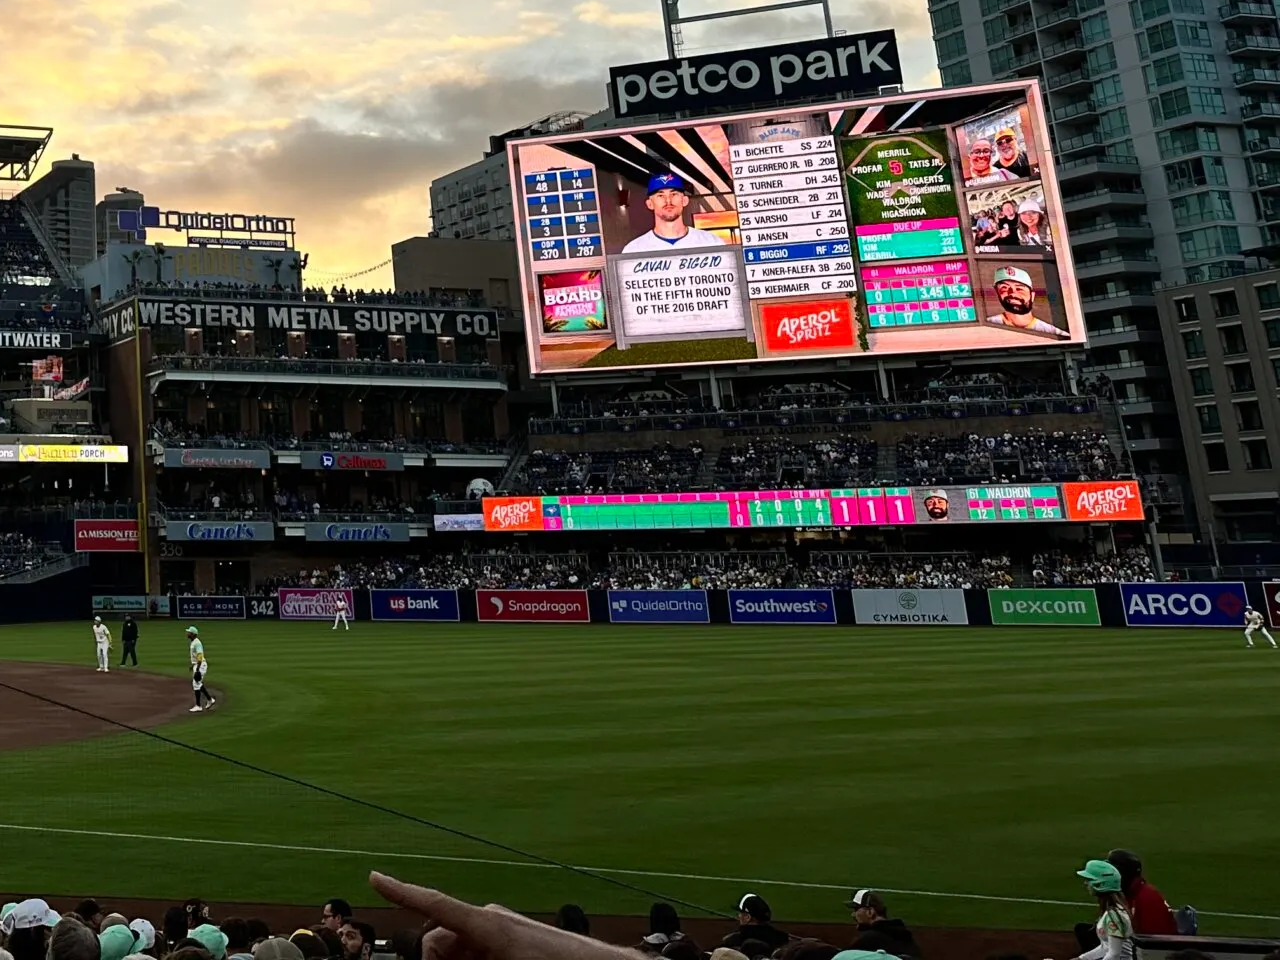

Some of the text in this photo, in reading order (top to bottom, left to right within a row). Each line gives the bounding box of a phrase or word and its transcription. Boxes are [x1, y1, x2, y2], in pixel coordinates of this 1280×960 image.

[616, 40, 893, 113] petco park
[759, 127, 801, 140] BLUE JAYS
[745, 140, 833, 157] BICHETTE SS .224
[877, 148, 911, 158] MERRILL
[734, 157, 836, 175] 27 GUERRERO 1B .208
[852, 164, 883, 175] PROFAR
[908, 159, 930, 169] TATIS
[536, 182, 548, 191] 48
[572, 179, 582, 188] 14
[739, 174, 838, 192] 2 TURNER DH .345
[876, 180, 891, 188] KIM
[902, 175, 944, 186] BOGAERTS
[866, 190, 890, 199] WADE
[909, 184, 951, 196] CRONENWORTH
[738, 192, 839, 209] 36 SCHNEIDER 2B .211
[882, 196, 921, 206] WALDRON
[541, 205, 547, 214] 4
[881, 208, 927, 219] HIGASHIOKA
[166, 211, 287, 232] QuidelOrtho
[741, 209, 842, 226] 25 VARSHO LF .214
[544, 227, 550, 236] 3
[580, 224, 586, 233] 5
[893, 221, 922, 231] DUE UP
[745, 226, 846, 243] 9 JANSEN C .250
[862, 234, 892, 243] PROFAR
[540, 249, 559, 260] .370
[576, 246, 594, 256] .787
[748, 244, 849, 260] 8 BIGGIO RF .292
[863, 244, 878, 252] KIM
[864, 252, 897, 261] MERRILL
[174, 250, 254, 282] PADRES
[634, 256, 721, 274] CAVAN BIGGIO
[750, 262, 851, 277] 7 KINER-FALEFA 3B .260
[894, 263, 962, 275] WALDRON RHP
[625, 273, 734, 290] SELECTED BY TORONTO
[750, 280, 854, 295] 39 KIERMAIER CF .200
[631, 286, 731, 302] IN THE FIFTH ROUND
[920, 286, 944, 299] 3.45
[947, 285, 969, 296] 15.2
[544, 290, 602, 306] BOARD
[636, 300, 729, 315] OF THE 2016 DRAFT
[138, 301, 497, 337] WESTERN METAL SUPPLY CO.
[879, 315, 886, 325] 6
[932, 311, 939, 321] 6
[956, 310, 968, 320] 16
[777, 308, 840, 337] APEROL
[789, 324, 831, 344] SPRITZ
[80, 449, 104, 458] PORCH
[985, 487, 1032, 499] WALDRON
[1077, 485, 1134, 510] APEROL
[491, 501, 536, 522] APEROL
[840, 500, 850, 522] 1
[867, 500, 876, 522] 1
[895, 499, 904, 521] 1
[978, 509, 988, 519] 12
[1010, 509, 1020, 518] 13
[1041, 508, 1054, 518] 25
[1088, 500, 1127, 517] SPRITZ
[500, 513, 529, 528] SPRITZ
[88, 530, 124, 538] MISSION
[187, 523, 254, 540] Canel's
[326, 524, 391, 540] Canel's
[159, 542, 184, 556] 336
[251, 601, 274, 615] 342
[389, 596, 439, 609] us bank
[508, 599, 582, 613] Snapdragon
[631, 599, 703, 611] QuidelOrtho
[735, 599, 813, 613] Southwest
[1129, 593, 1211, 616] ARCO
[873, 613, 948, 623] CYMBIOTIKA
